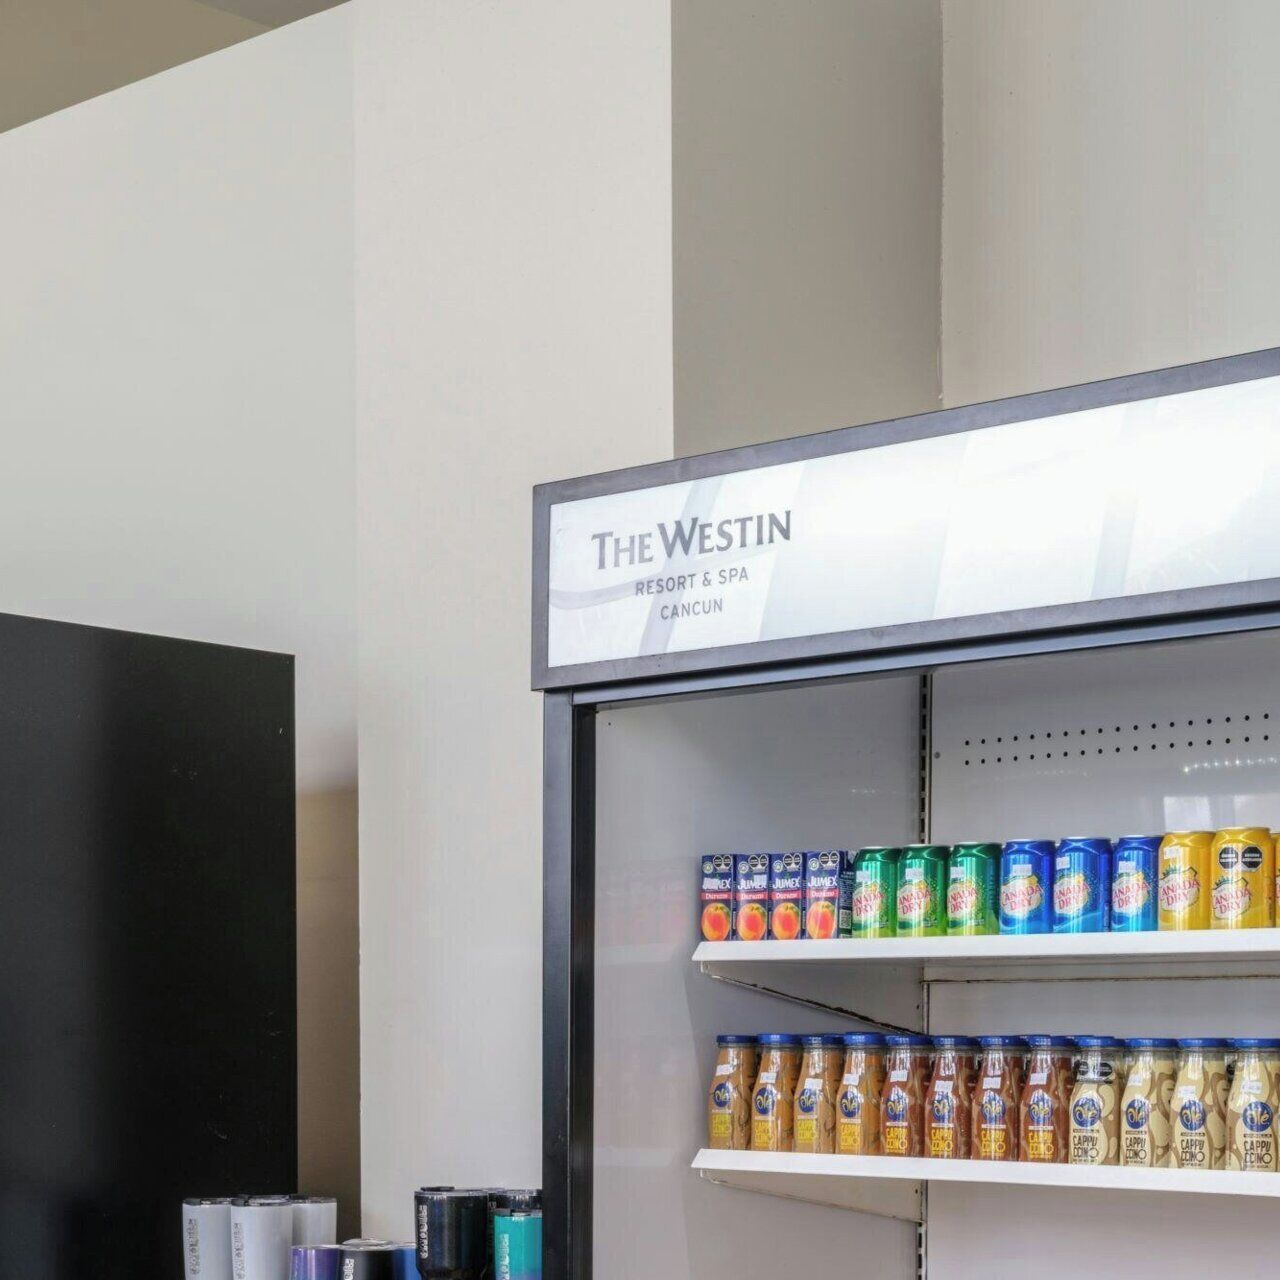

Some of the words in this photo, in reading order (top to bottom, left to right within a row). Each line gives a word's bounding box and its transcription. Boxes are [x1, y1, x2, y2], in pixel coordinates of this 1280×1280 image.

[591, 531, 654, 570] THE
[657, 510, 791, 559] WESTIN
[635, 574, 695, 596] RESORT
[702, 571, 712, 587] &
[718, 566, 749, 585] SPA
[660, 598, 723, 620] CANCUN
